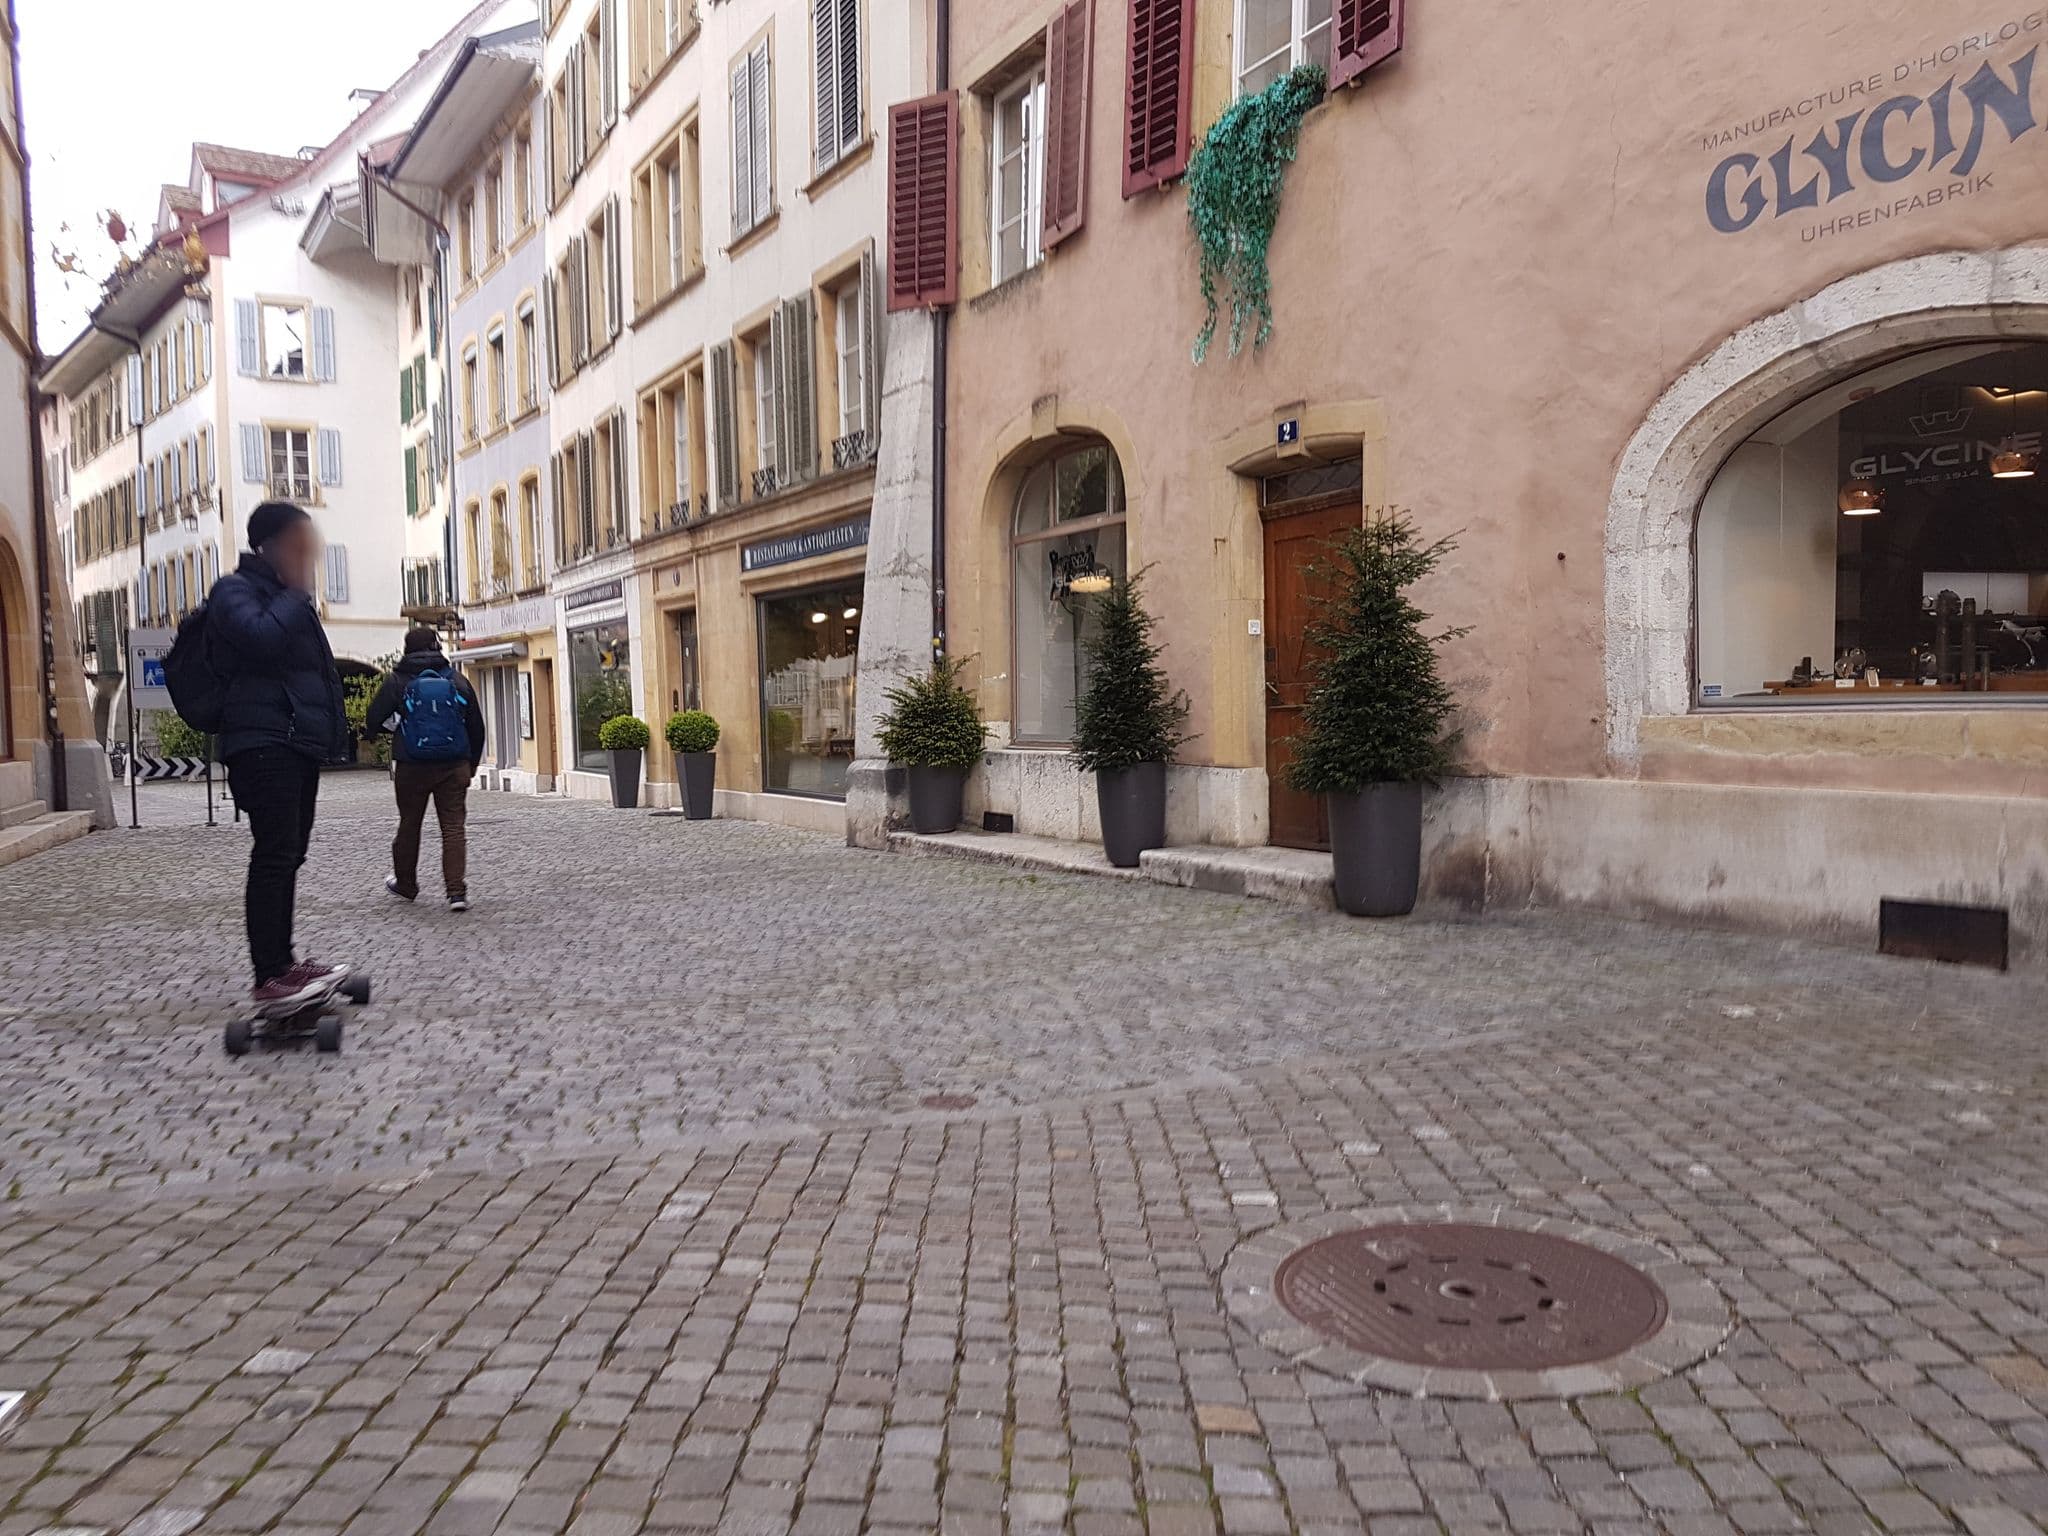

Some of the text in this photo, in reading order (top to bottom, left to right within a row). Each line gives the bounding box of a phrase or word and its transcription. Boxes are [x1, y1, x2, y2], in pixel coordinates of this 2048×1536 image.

[1702, 9, 2048, 151] MANUFACTURE D'HORLOG
[1705, 43, 2048, 233] GLYCIN
[1800, 171, 1995, 243] UHRENFABRIK
[1283, 422, 1291, 441] 2
[1850, 431, 2043, 478] GLYCINE
[1904, 468, 1979, 487] SINCE 1914
